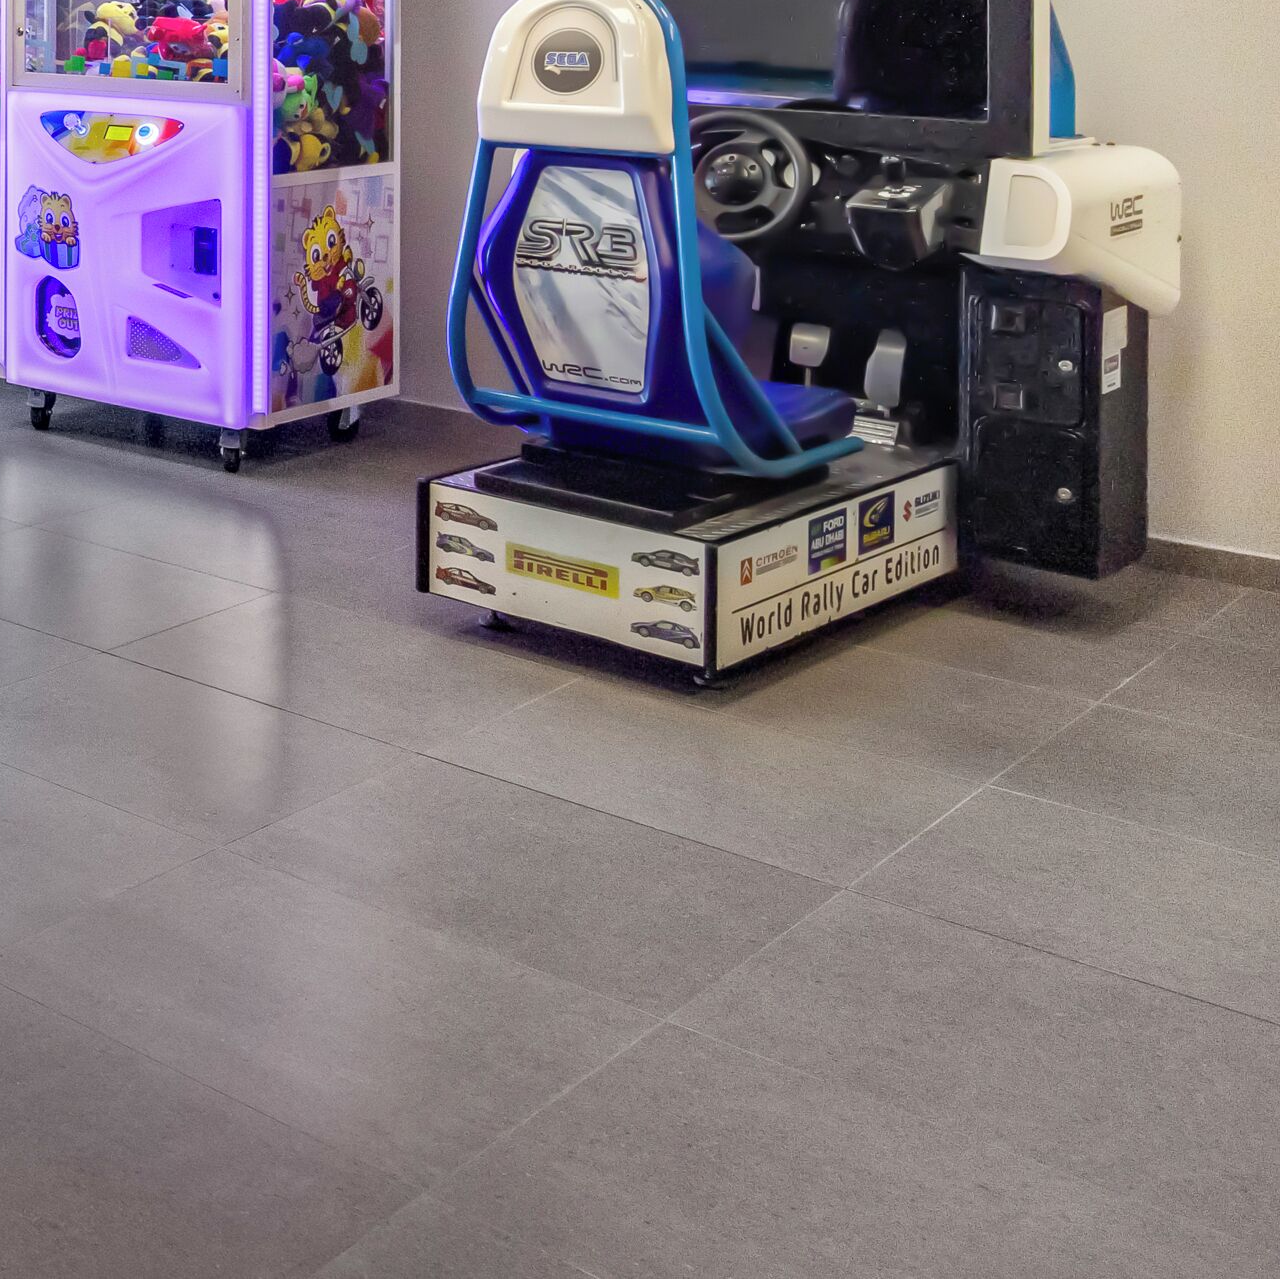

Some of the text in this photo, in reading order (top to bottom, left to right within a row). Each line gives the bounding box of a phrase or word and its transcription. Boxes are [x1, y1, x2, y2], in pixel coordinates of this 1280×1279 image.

[544, 51, 590, 67] SEGA
[823, 515, 845, 533] FORD
[811, 535, 824, 550] ABU
[513, 549, 609, 591] PIRELLI
[741, 598, 792, 646] World
[801, 581, 844, 612] Rally
[851, 570, 878, 598] Car
[885, 544, 940, 585] Edition
